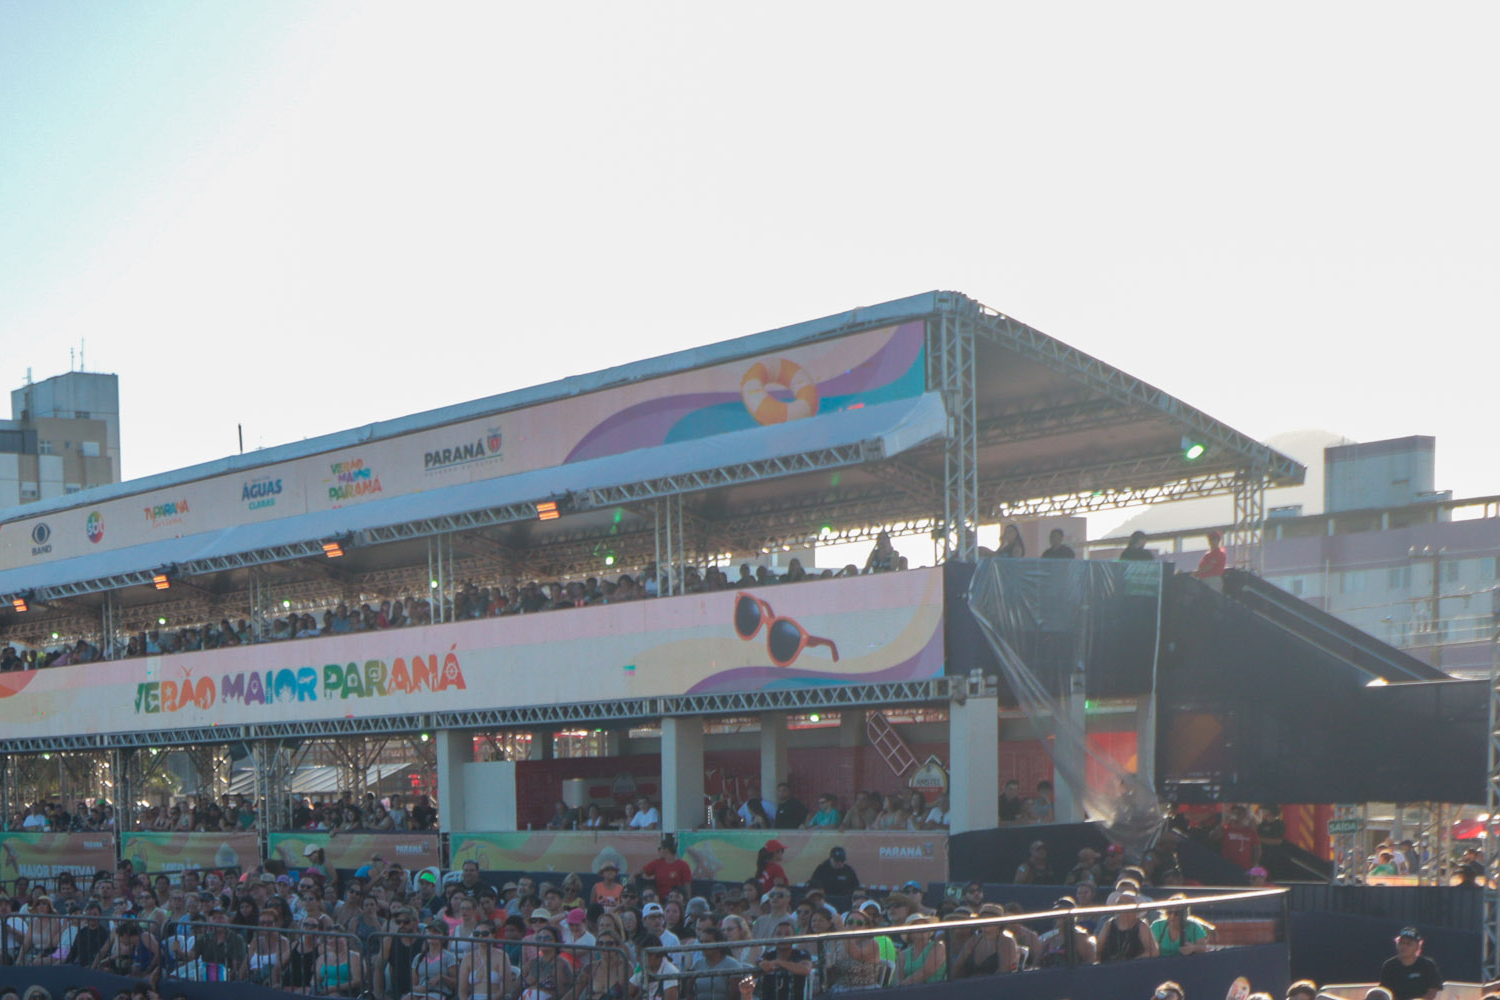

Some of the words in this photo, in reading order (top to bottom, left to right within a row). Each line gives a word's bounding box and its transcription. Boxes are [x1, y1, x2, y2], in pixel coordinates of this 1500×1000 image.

[424, 438, 485, 468] PARANÁ
[330, 458, 363, 475] VERÃO
[242, 478, 282, 502] ÁGUAS
[329, 476, 382, 501] PARANÁ
[31, 545, 52, 556] BAND
[134, 665, 216, 715] VERÃO
[221, 667, 317, 705] MAIOR
[323, 643, 466, 700] PARANÁ
[880, 845, 923, 857] PARANÁ
